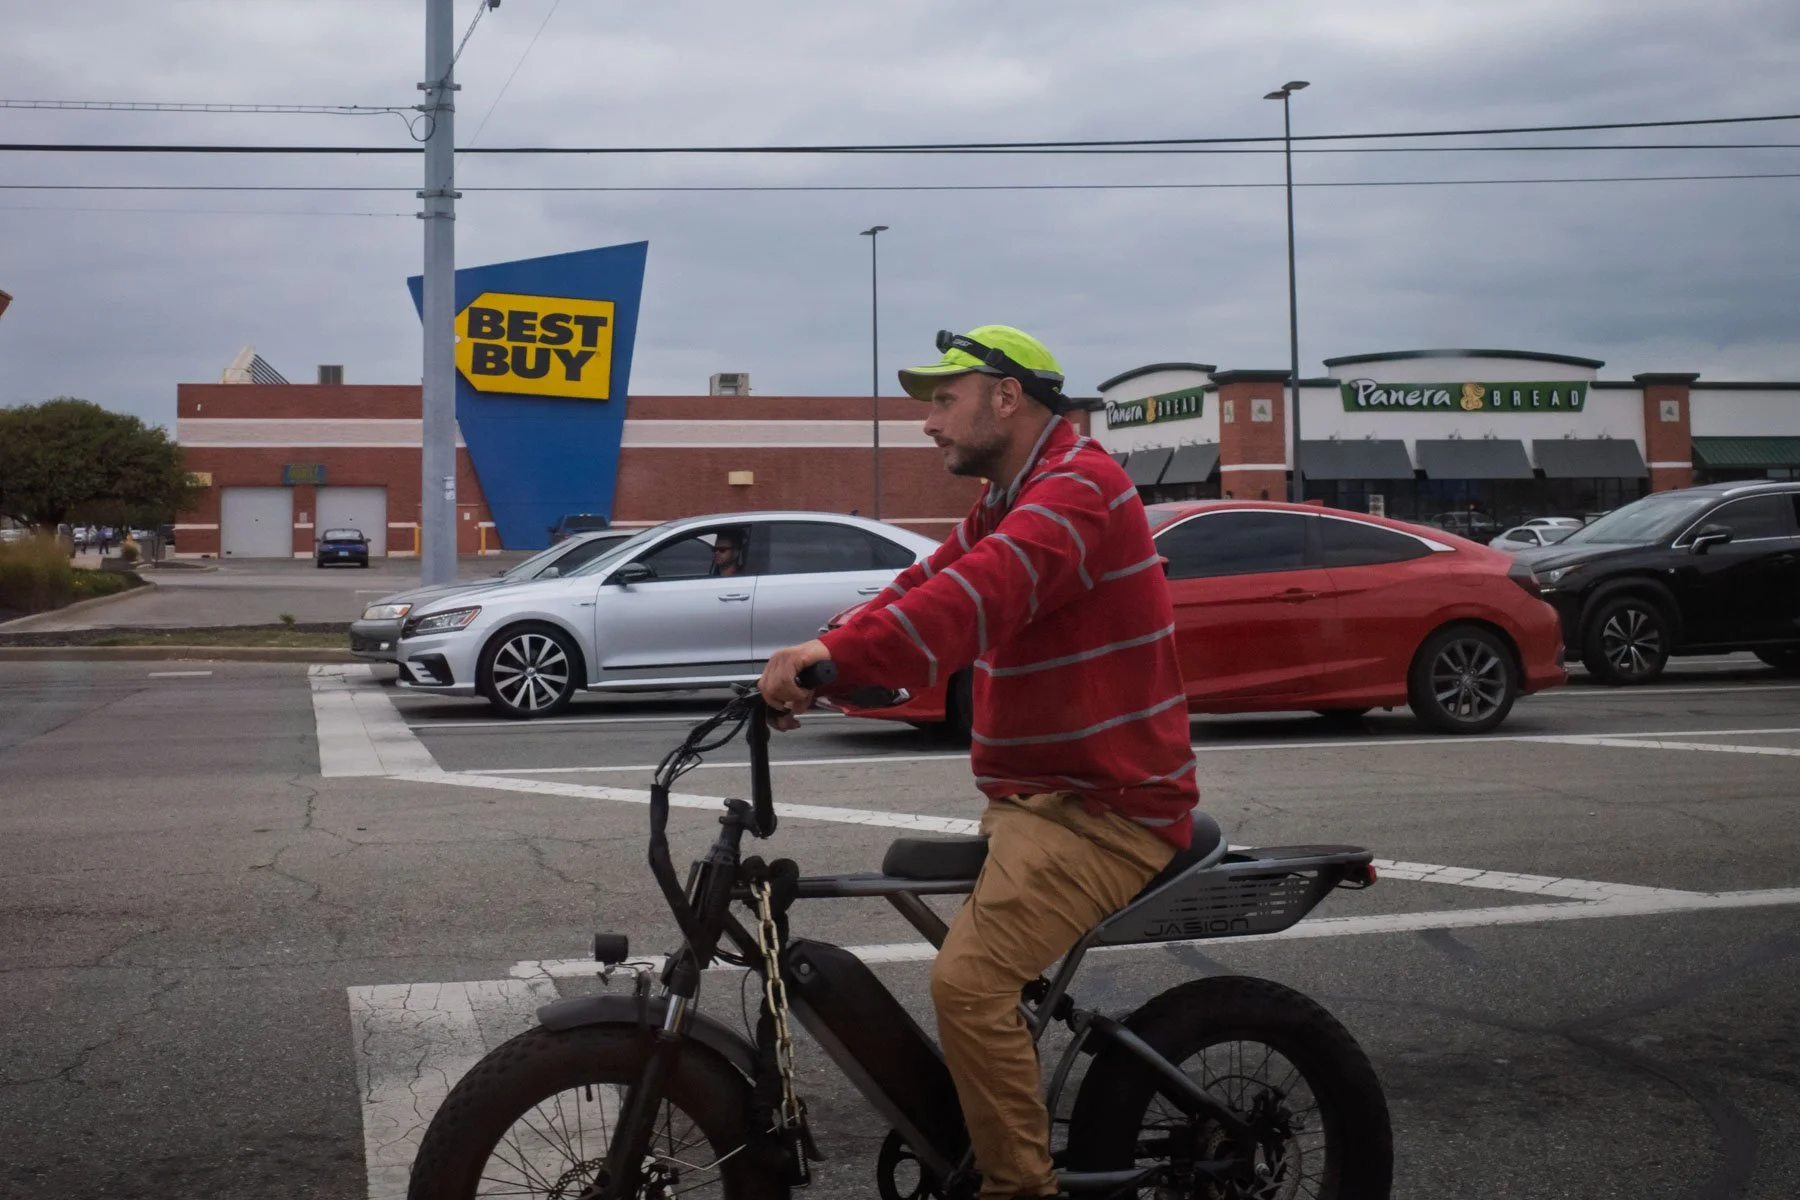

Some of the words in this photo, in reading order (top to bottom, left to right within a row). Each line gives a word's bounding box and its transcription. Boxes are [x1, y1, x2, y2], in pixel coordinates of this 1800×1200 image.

[467, 307, 608, 347] BEST
[471, 342, 596, 381] BUY
[1351, 379, 1451, 406] Panera
[1493, 390, 1579, 406] BREAD
[1105, 401, 1143, 424] Panera
[1158, 396, 1196, 416] BREAD
[1144, 918, 1249, 936] JASION
